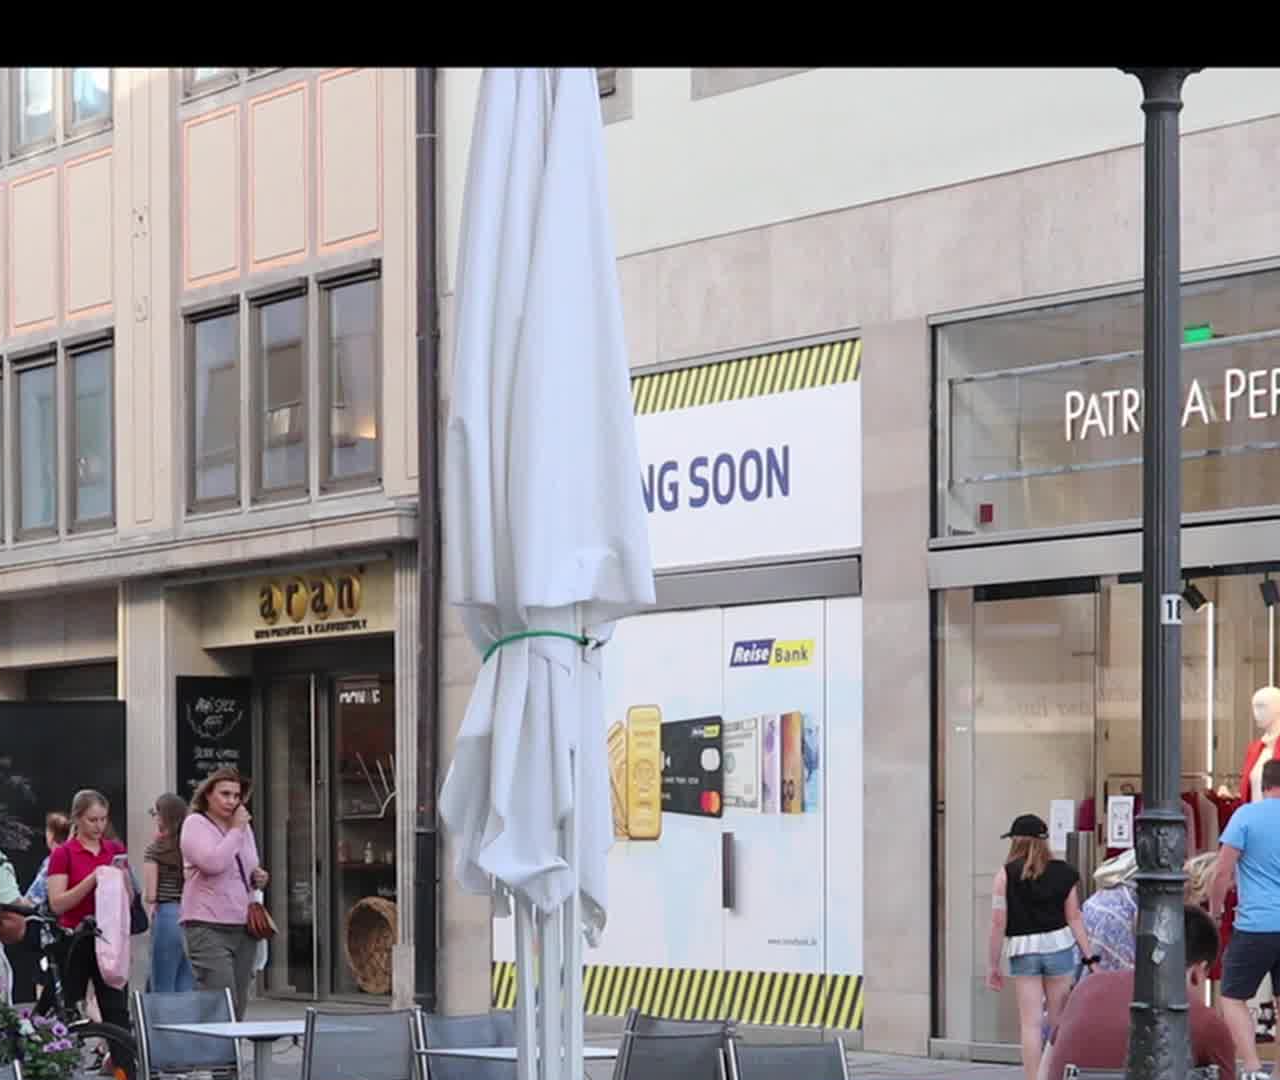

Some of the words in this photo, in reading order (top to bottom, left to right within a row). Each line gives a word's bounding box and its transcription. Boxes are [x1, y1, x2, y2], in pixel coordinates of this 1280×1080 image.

[1064, 378, 1210, 441] PATRA
[688, 444, 790, 508] SOON
[259, 577, 358, 619] aran
